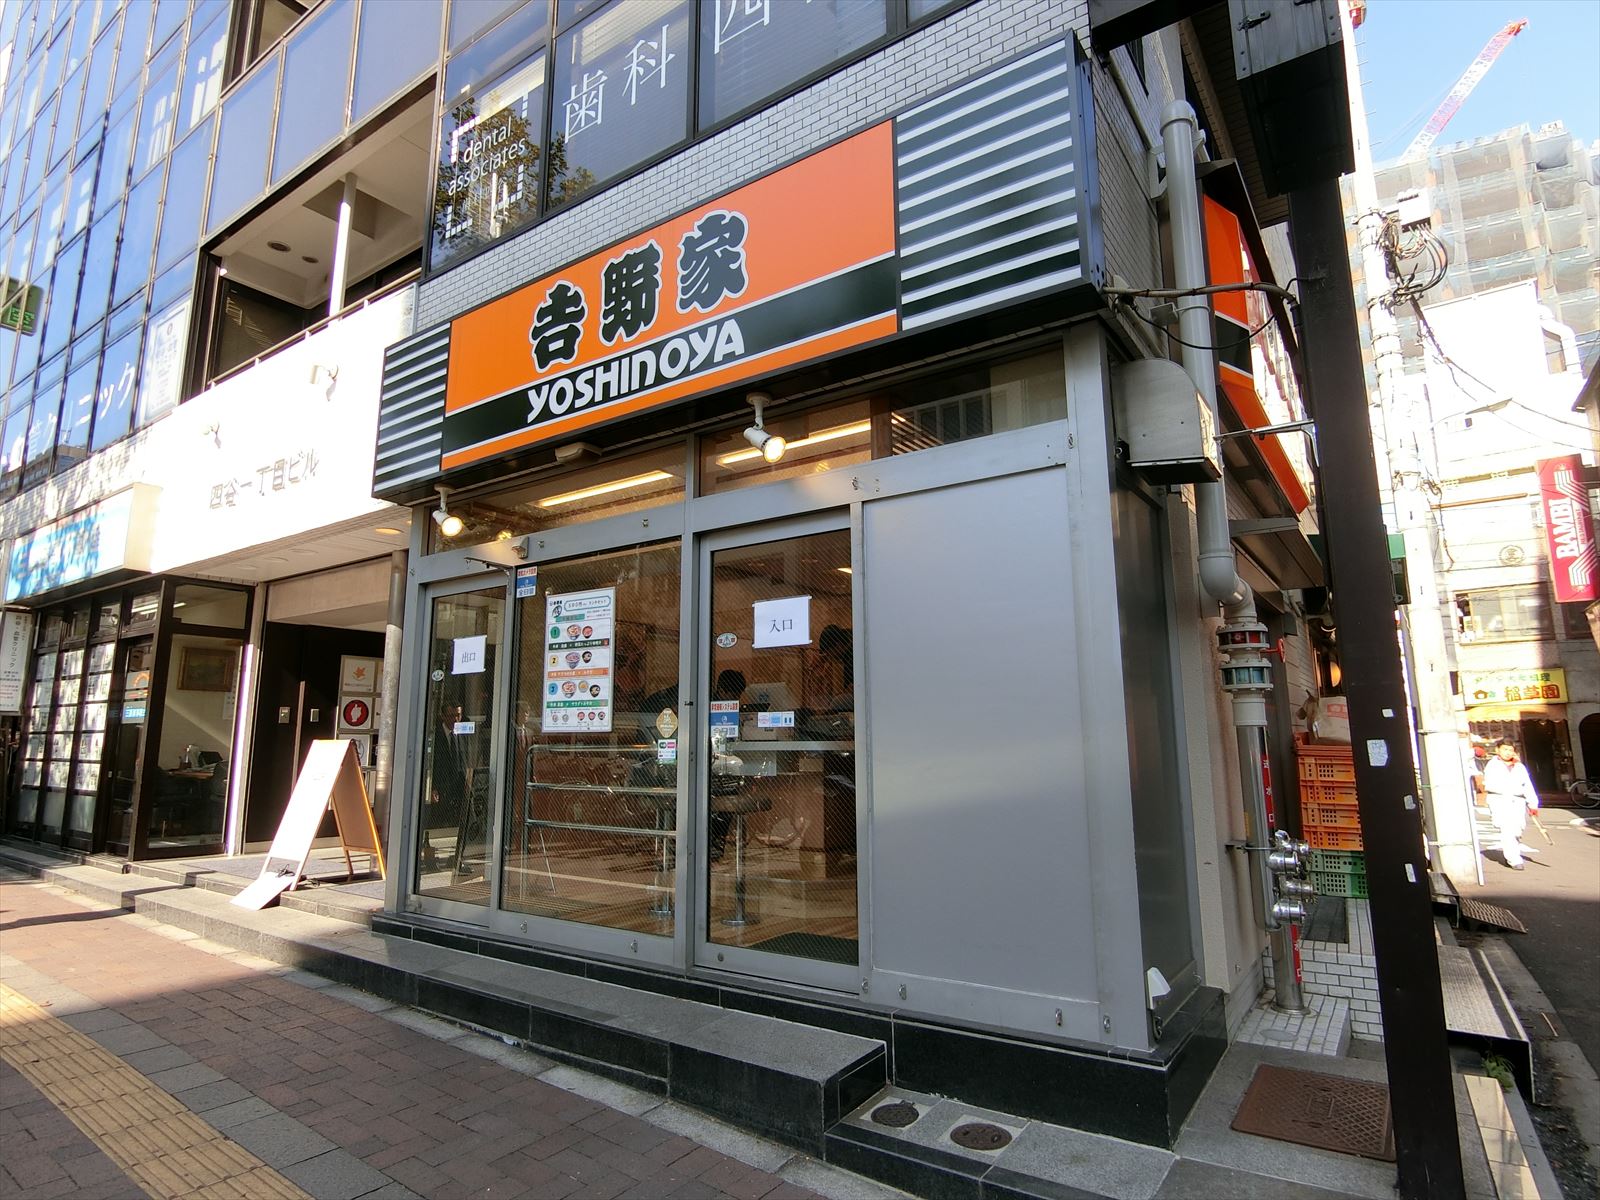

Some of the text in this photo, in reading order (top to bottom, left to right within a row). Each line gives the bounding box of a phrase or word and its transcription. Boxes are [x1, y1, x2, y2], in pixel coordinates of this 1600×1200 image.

[448, 138, 526, 196] associates
[464, 116, 511, 163] dental
[530, 209, 748, 373] 吉野家
[527, 319, 745, 423] YOSHINOYA
[210, 449, 320, 509] 四谷一丁目ビル
[1548, 497, 1581, 559] BAMBI
[769, 618, 793, 634] 入口
[461, 651, 477, 664] 出口
